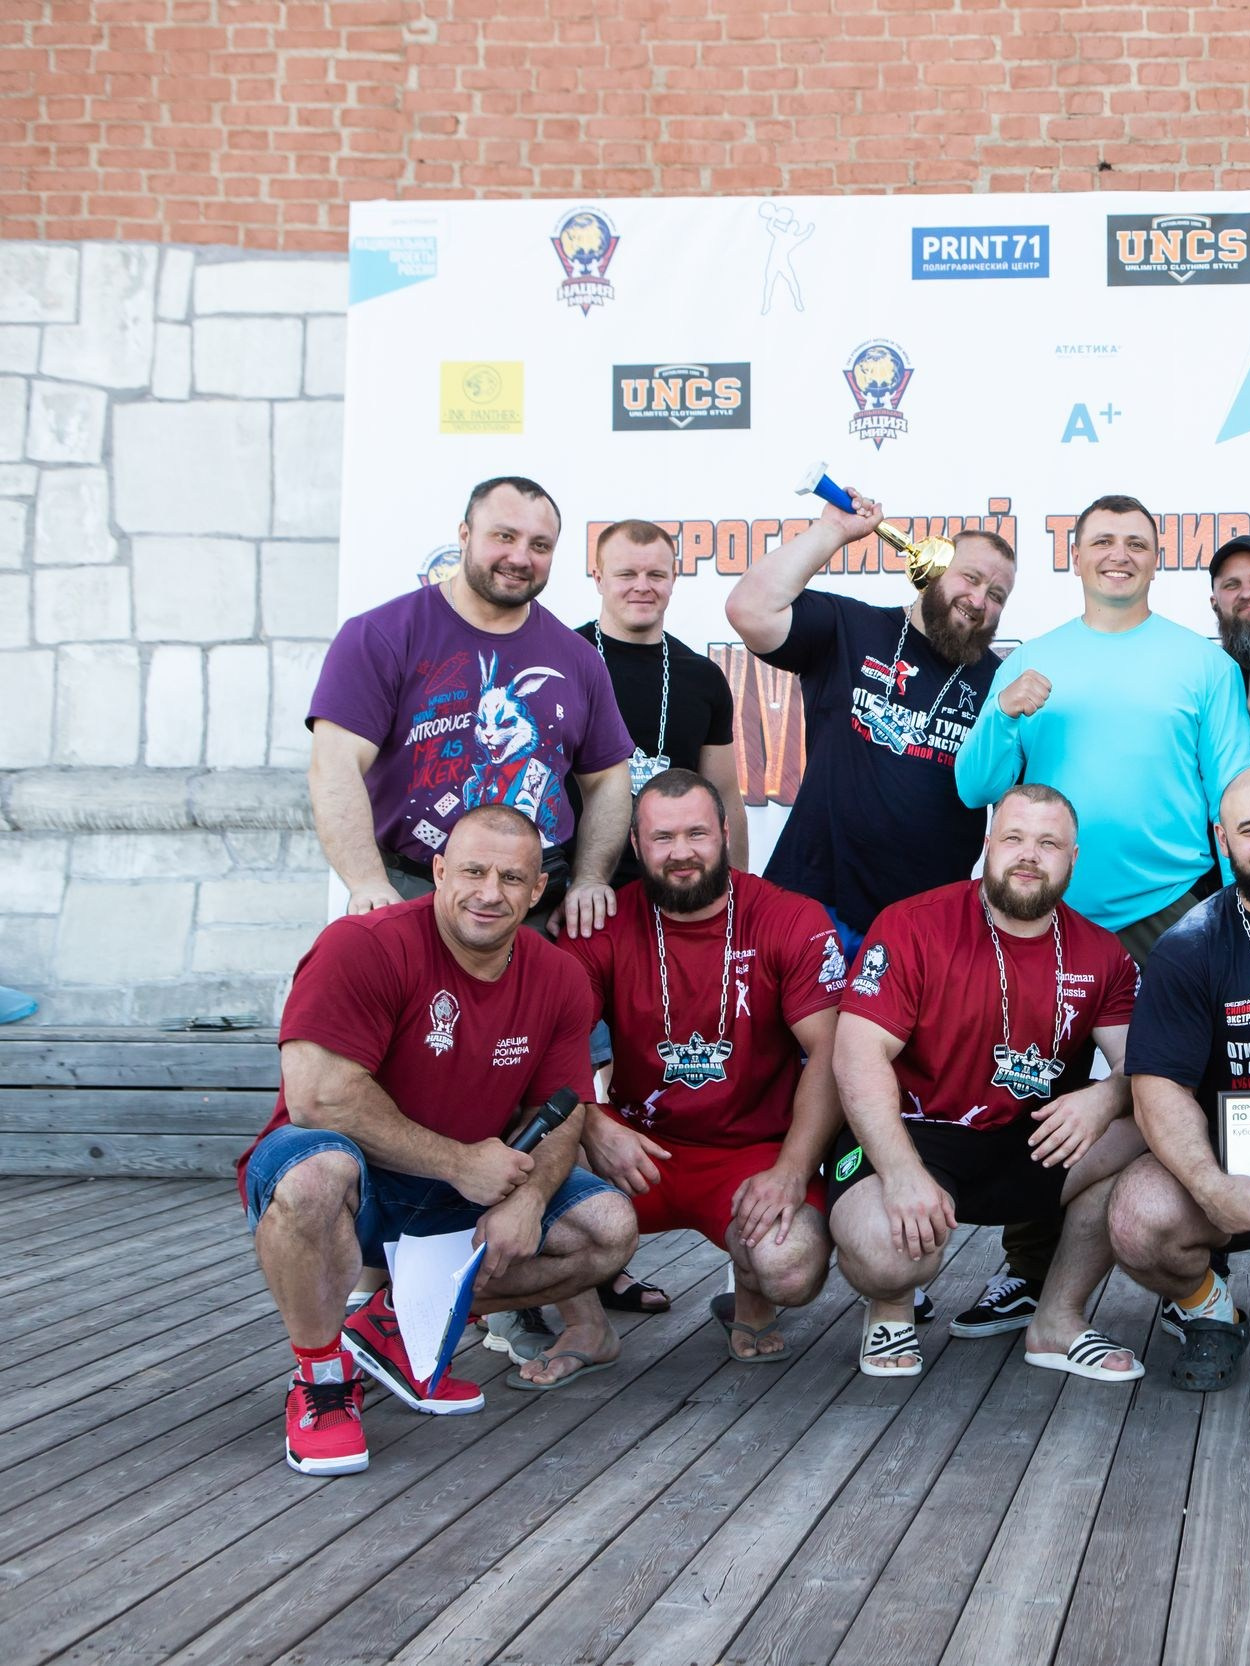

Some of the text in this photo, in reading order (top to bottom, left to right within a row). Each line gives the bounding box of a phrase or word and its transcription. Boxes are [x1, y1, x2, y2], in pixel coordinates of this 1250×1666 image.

[922, 235, 1040, 260] PRINT 71
[1116, 228, 1247, 264] UNCS
[923, 261, 1039, 271] ПОЛИГРАФИЧЕСКИЙ ЦЕНТР
[621, 377, 742, 410] UNCS
[849, 415, 908, 434] НАЦИЯ
[405, 712, 472, 745] INTRODUCE
[441, 739, 464, 758] AS
[1057, 986, 1087, 998] ussia
[1232, 1112, 1247, 1121] ПО
